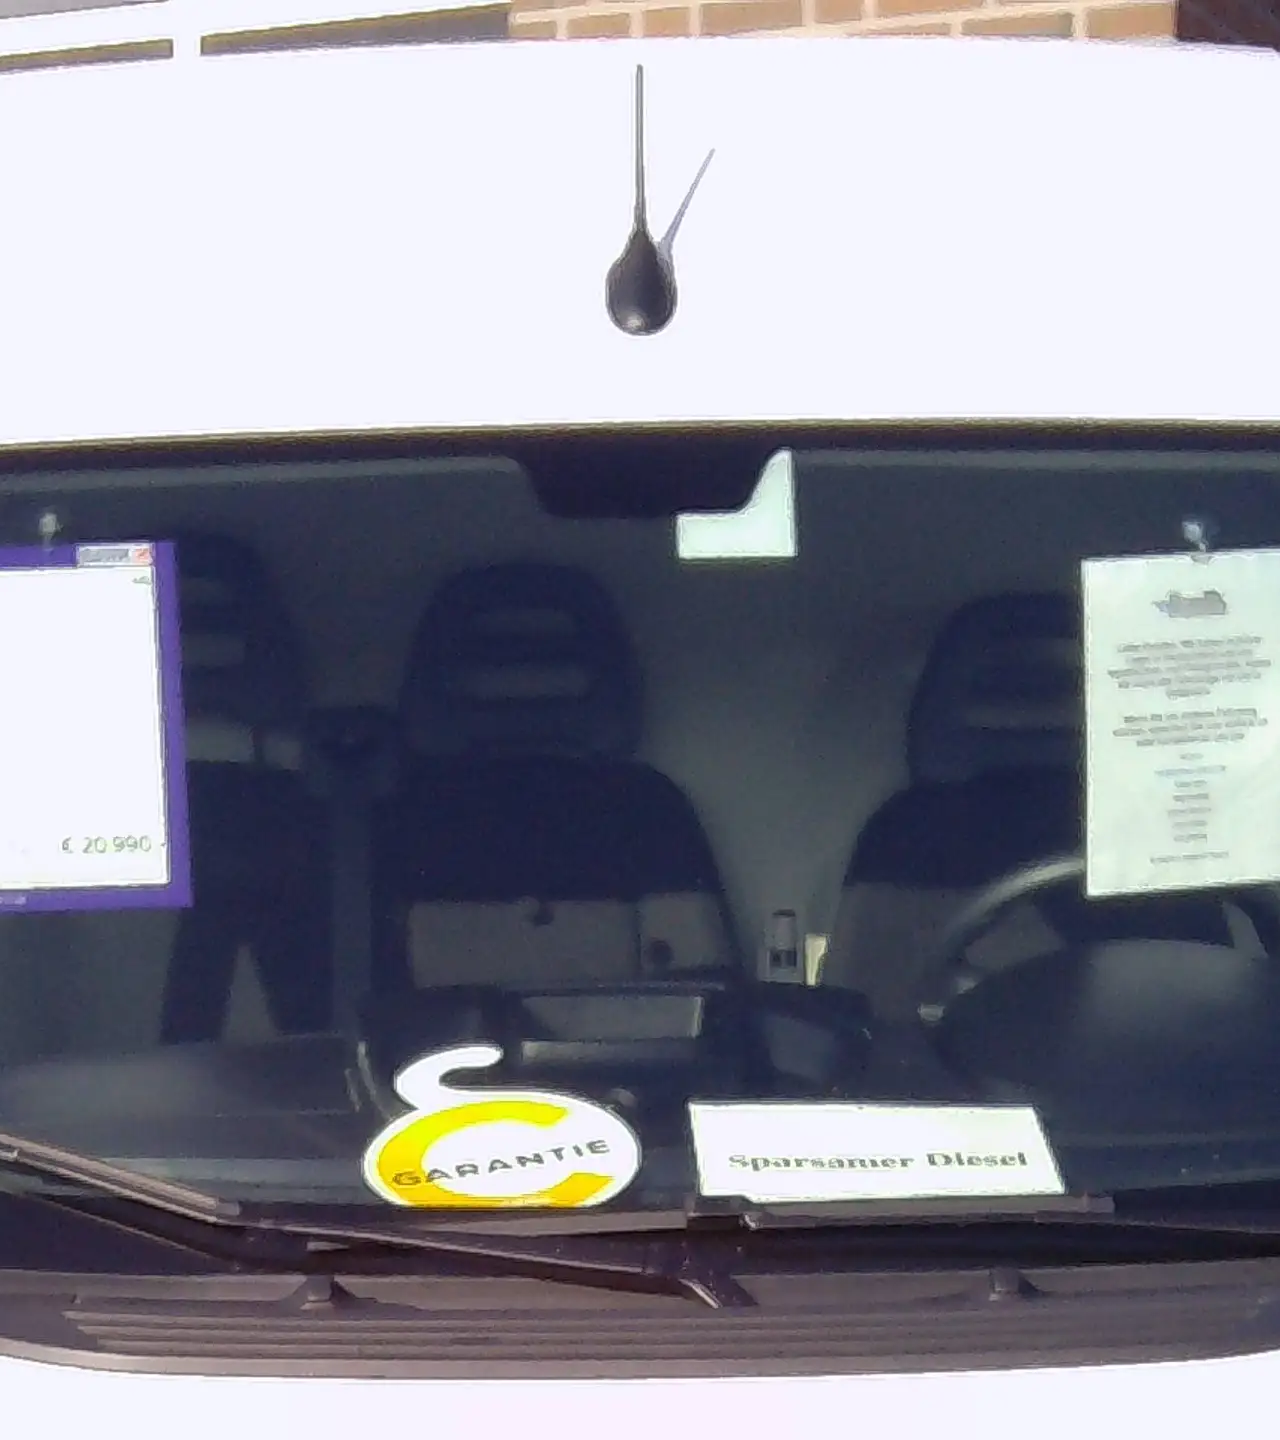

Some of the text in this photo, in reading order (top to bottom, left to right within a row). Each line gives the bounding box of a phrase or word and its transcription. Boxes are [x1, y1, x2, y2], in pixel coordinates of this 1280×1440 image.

[391, 1139, 611, 1187] GARANTIE
[728, 1152, 1028, 1171] Sparsamer Diesel
